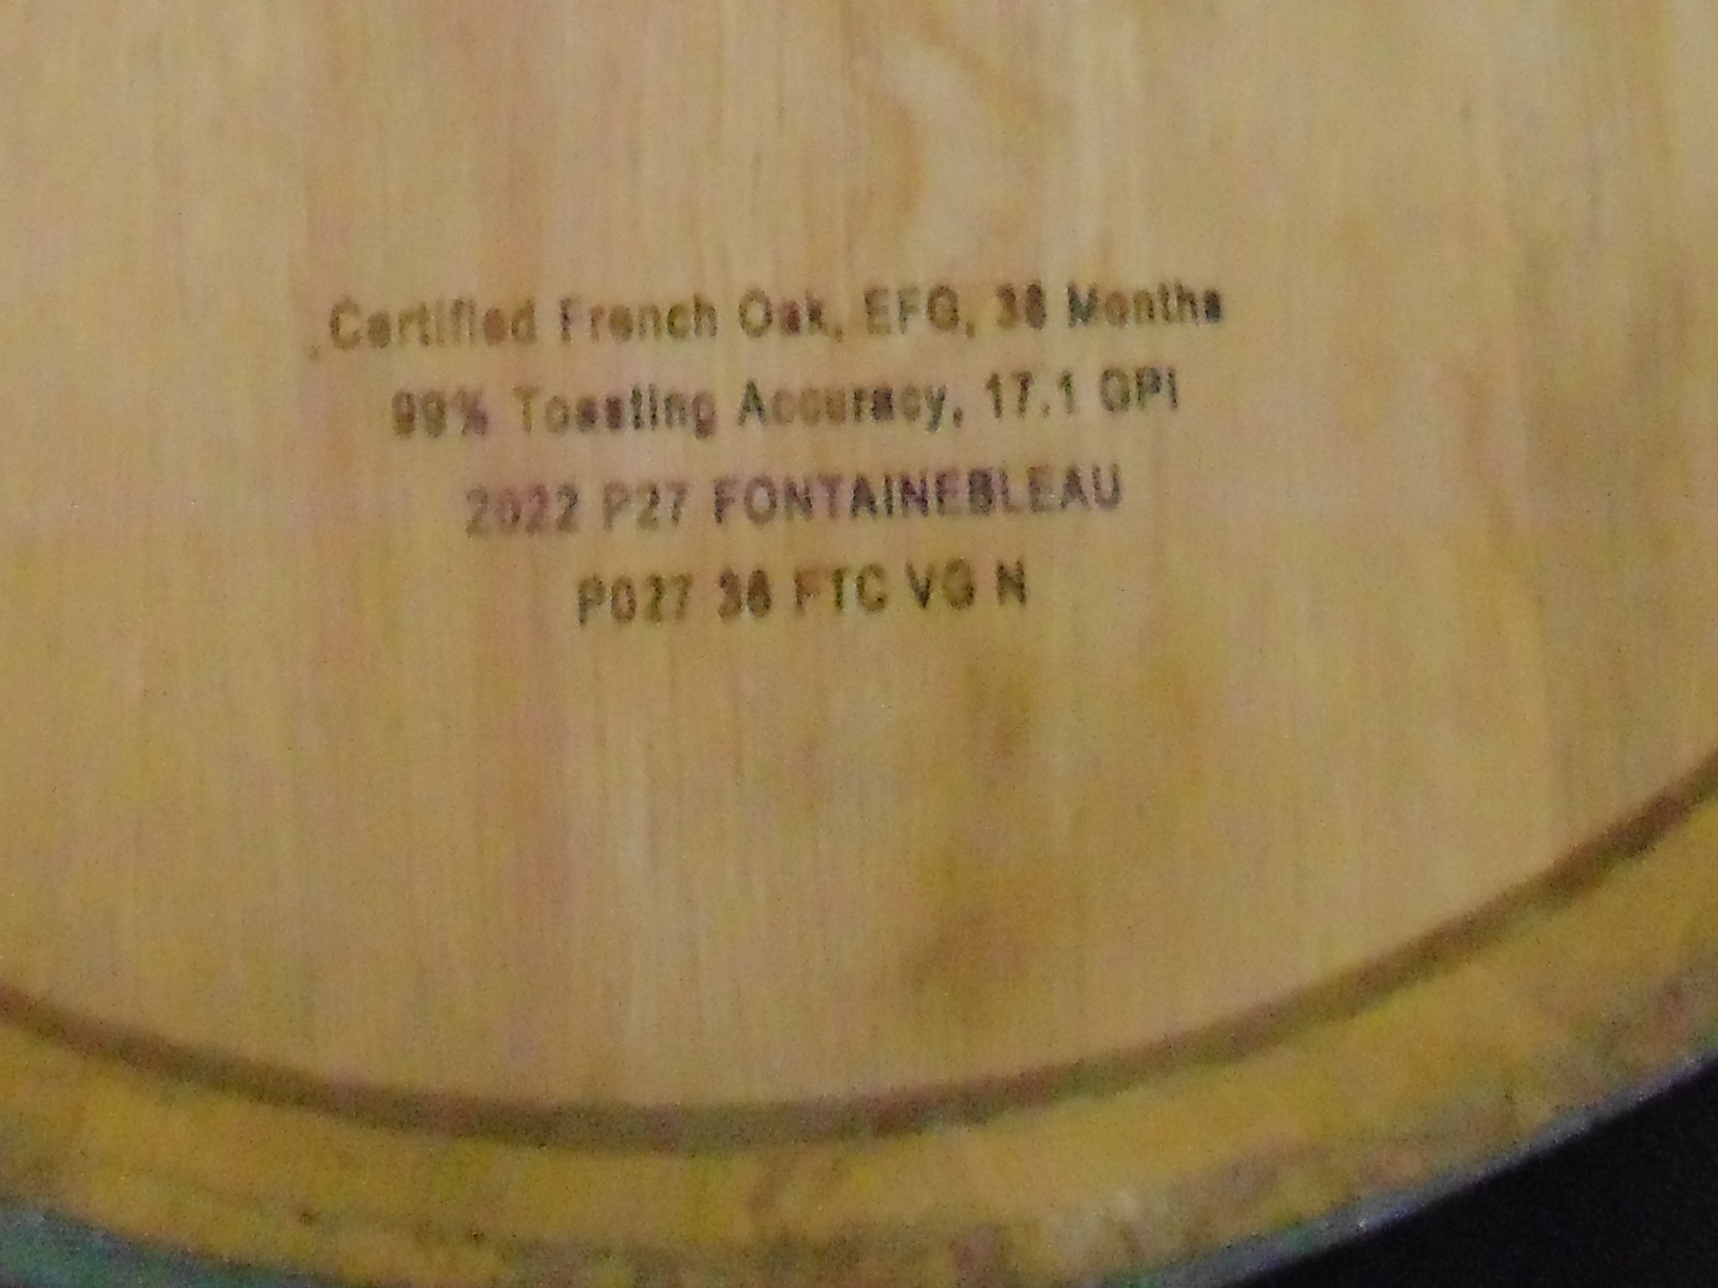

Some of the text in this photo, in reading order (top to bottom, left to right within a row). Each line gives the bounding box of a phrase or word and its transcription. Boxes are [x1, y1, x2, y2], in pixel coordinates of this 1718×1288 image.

[328, 294, 536, 351] Certified
[559, 290, 719, 344] French
[1067, 279, 1222, 329] Months
[512, 382, 718, 440] Toasting
[985, 368, 1075, 420] 17.1
[465, 462, 1123, 537] 2022 P27 FONTAINEBLEAU
[995, 554, 1028, 608] N
